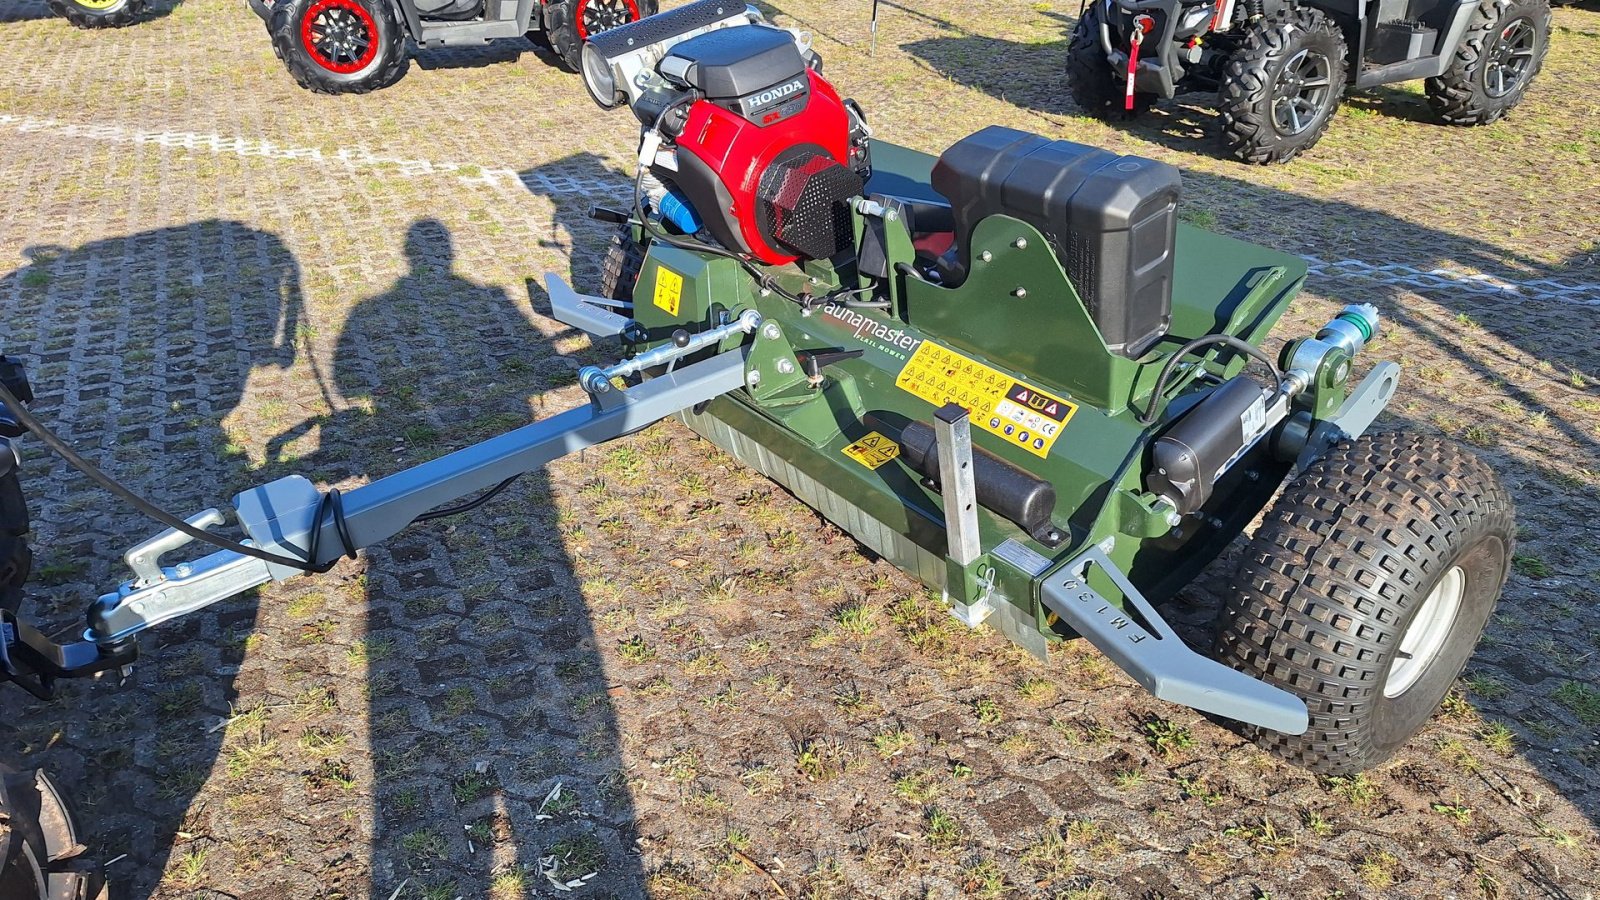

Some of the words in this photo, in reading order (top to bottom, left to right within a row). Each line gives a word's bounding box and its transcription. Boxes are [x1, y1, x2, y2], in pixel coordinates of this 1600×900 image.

[747, 80, 804, 109] HONDA
[817, 301, 921, 352] aunamaster
[856, 334, 877, 348] FLAIL
[878, 344, 906, 361] MOWER
[1062, 579, 1146, 644] FM130
